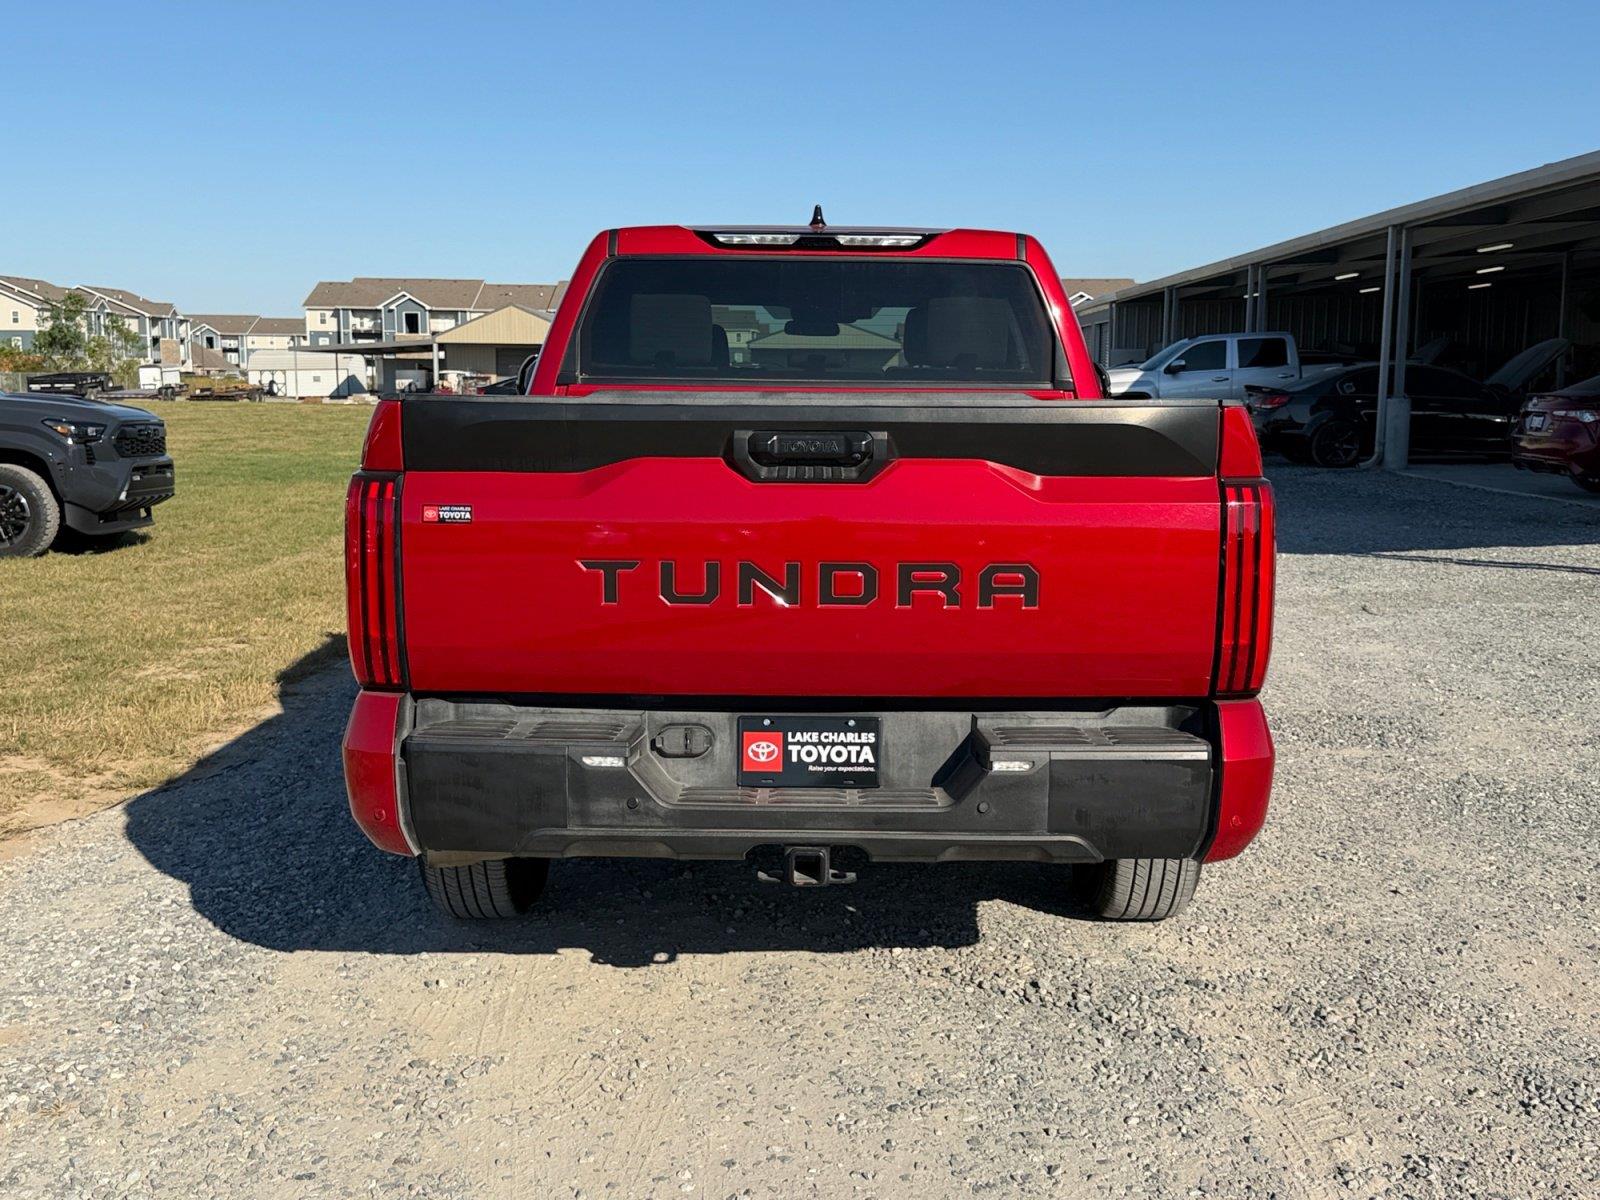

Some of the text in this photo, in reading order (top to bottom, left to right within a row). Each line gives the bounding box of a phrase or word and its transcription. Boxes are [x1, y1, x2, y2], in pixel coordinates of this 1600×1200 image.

[783, 440, 838, 452] TOYOTA
[439, 511, 471, 519] TOYOTA
[576, 560, 1040, 610] TUNDRA
[788, 732, 875, 743] LAKE CHARLES
[788, 745, 875, 763] TOYOTA
